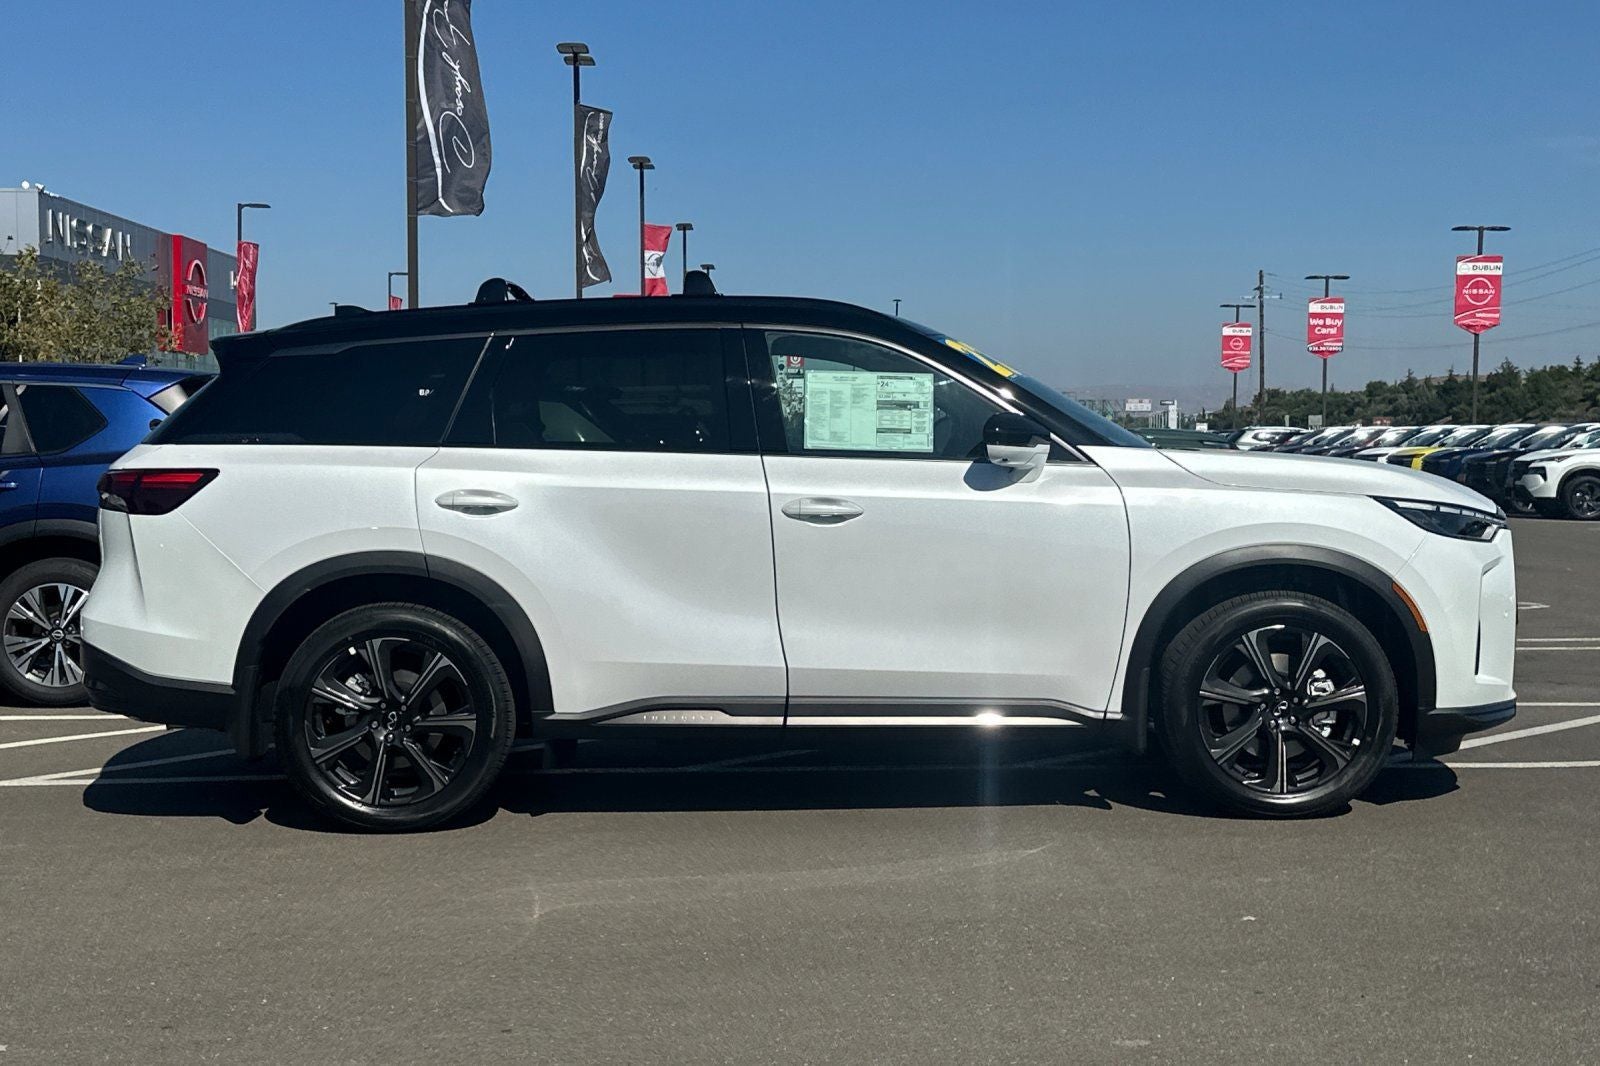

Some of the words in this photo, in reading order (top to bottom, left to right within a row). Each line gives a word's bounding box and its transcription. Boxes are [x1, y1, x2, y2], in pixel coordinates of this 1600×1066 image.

[46, 209, 131, 261] NISSAN
[186, 284, 208, 299] NISSAN
[1309, 317, 1325, 326] We
[1325, 317, 1343, 327] Buy
